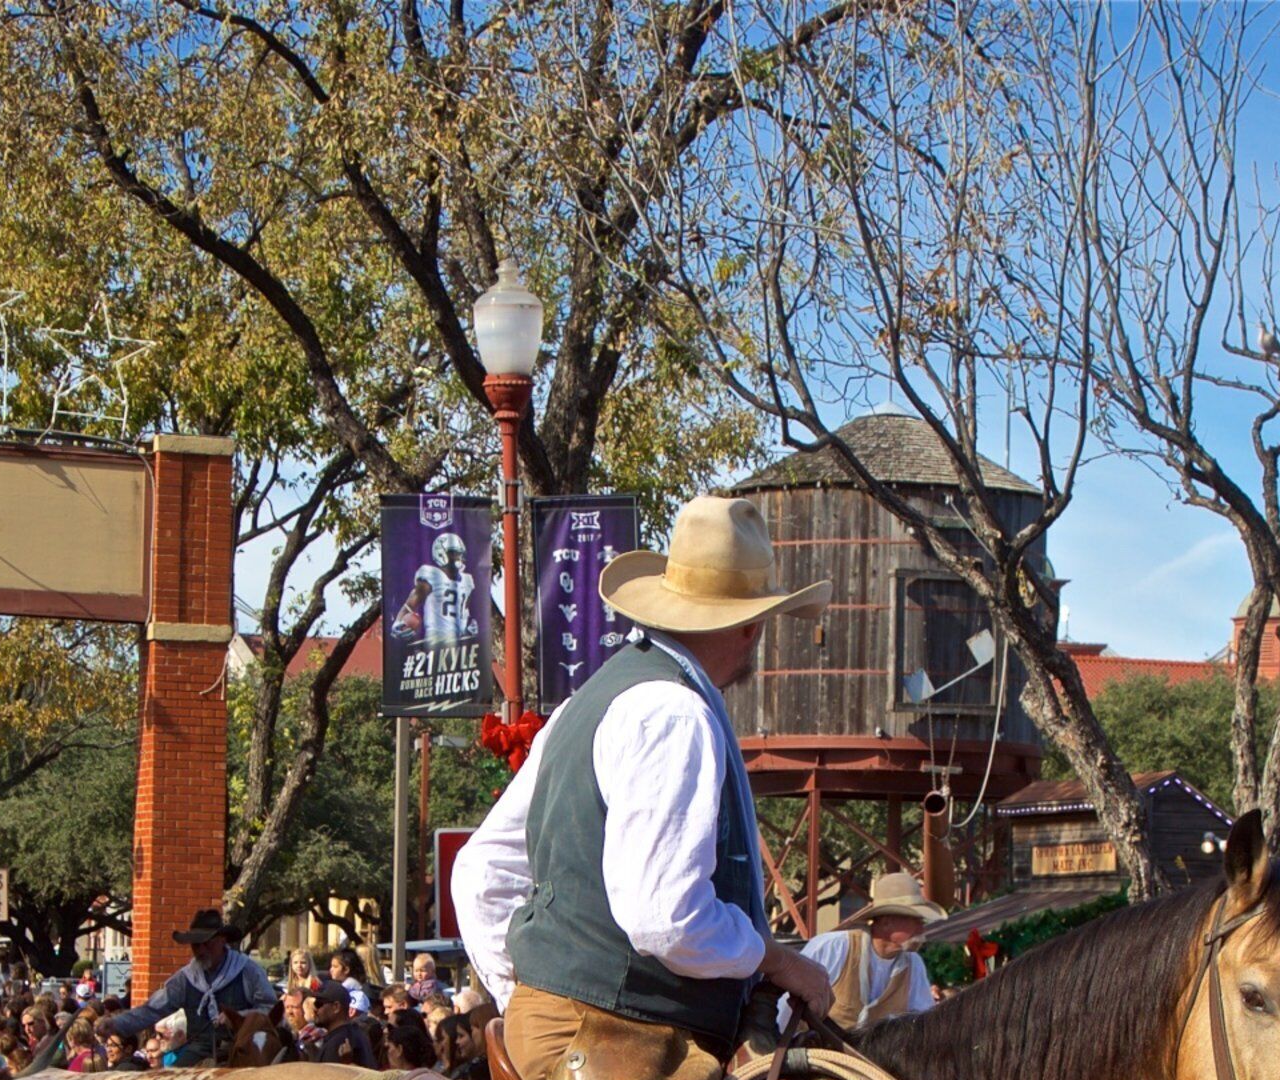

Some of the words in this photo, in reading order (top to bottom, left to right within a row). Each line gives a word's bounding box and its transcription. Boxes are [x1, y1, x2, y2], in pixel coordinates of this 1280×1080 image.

[427, 499, 448, 509] TCU
[553, 549, 580, 562] TCU
[403, 651, 434, 678] #21
[437, 644, 479, 672] KYLE
[434, 670, 481, 695] HICKS
